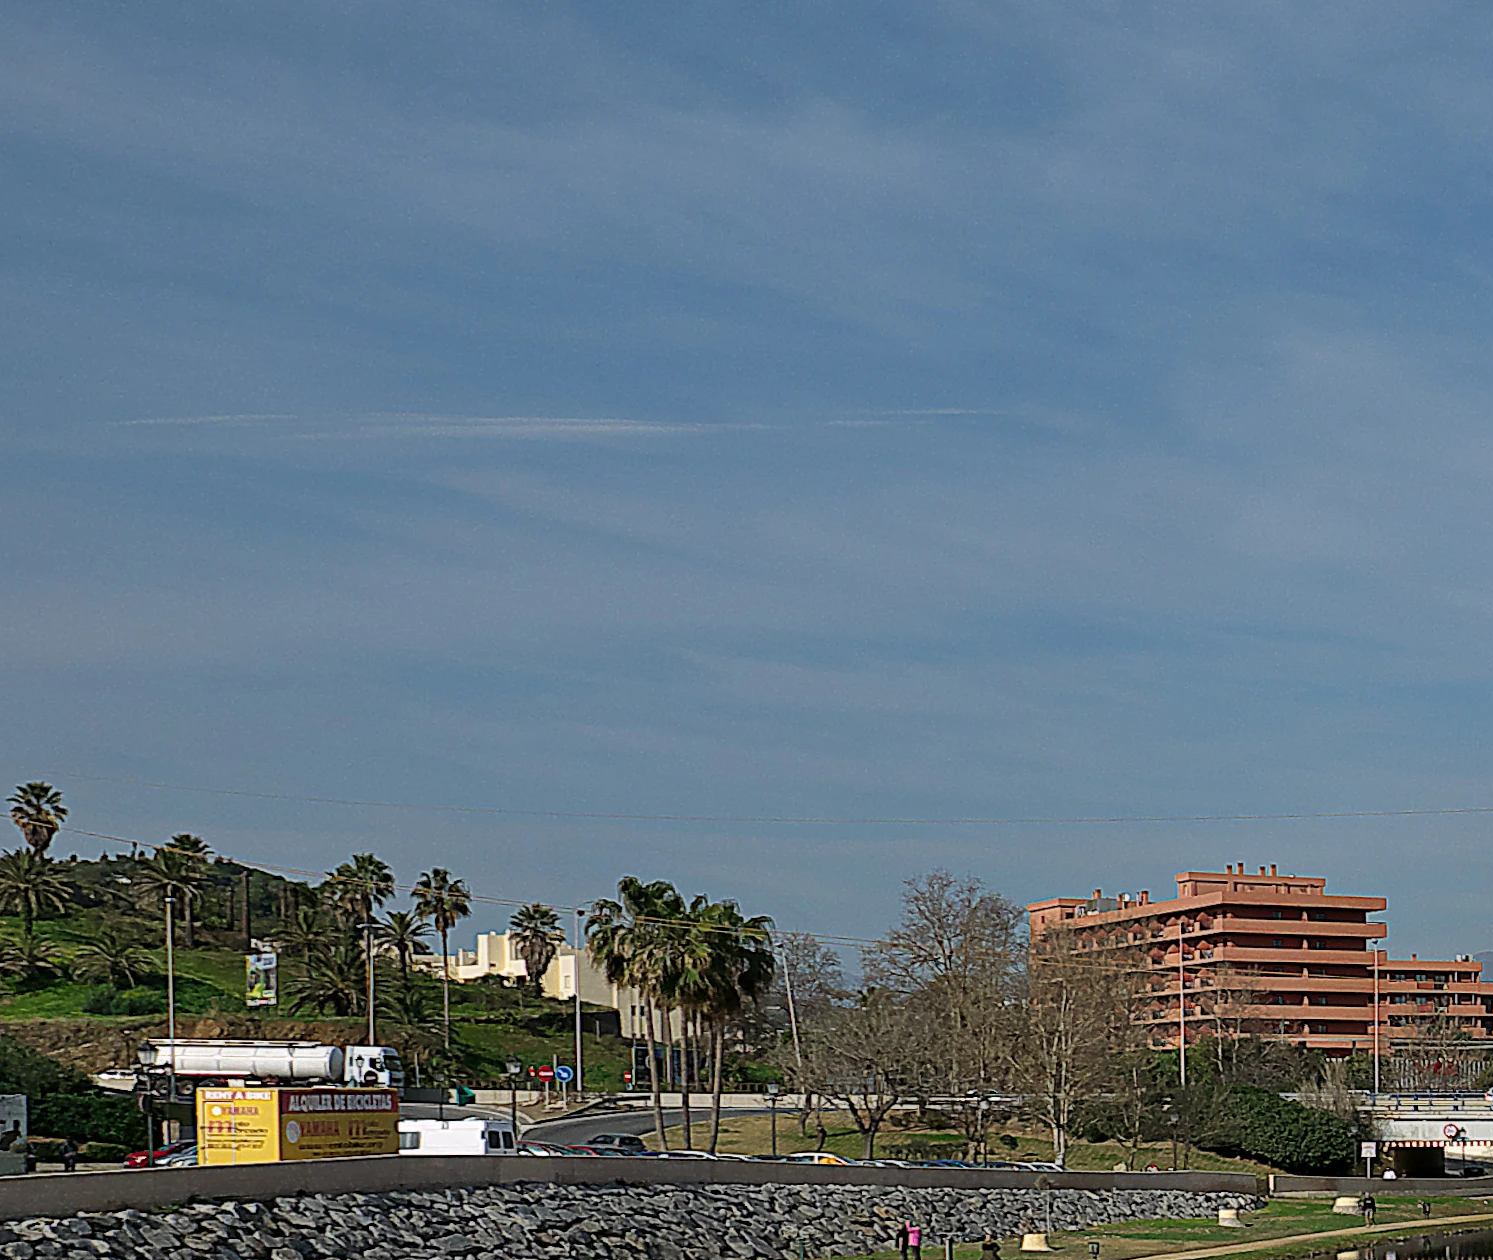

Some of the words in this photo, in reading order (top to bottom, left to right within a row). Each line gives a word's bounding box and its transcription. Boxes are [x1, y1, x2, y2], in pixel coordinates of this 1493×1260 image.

[205, 1091, 232, 1100] RENT
[234, 1091, 244, 1100] A
[246, 1091, 271, 1100] BIKE
[289, 1095, 332, 1111] ALQUILER
[334, 1095, 346, 1110] DE
[347, 1094, 392, 1110] BICICLETAS
[300, 1120, 340, 1136] YAMAHA
